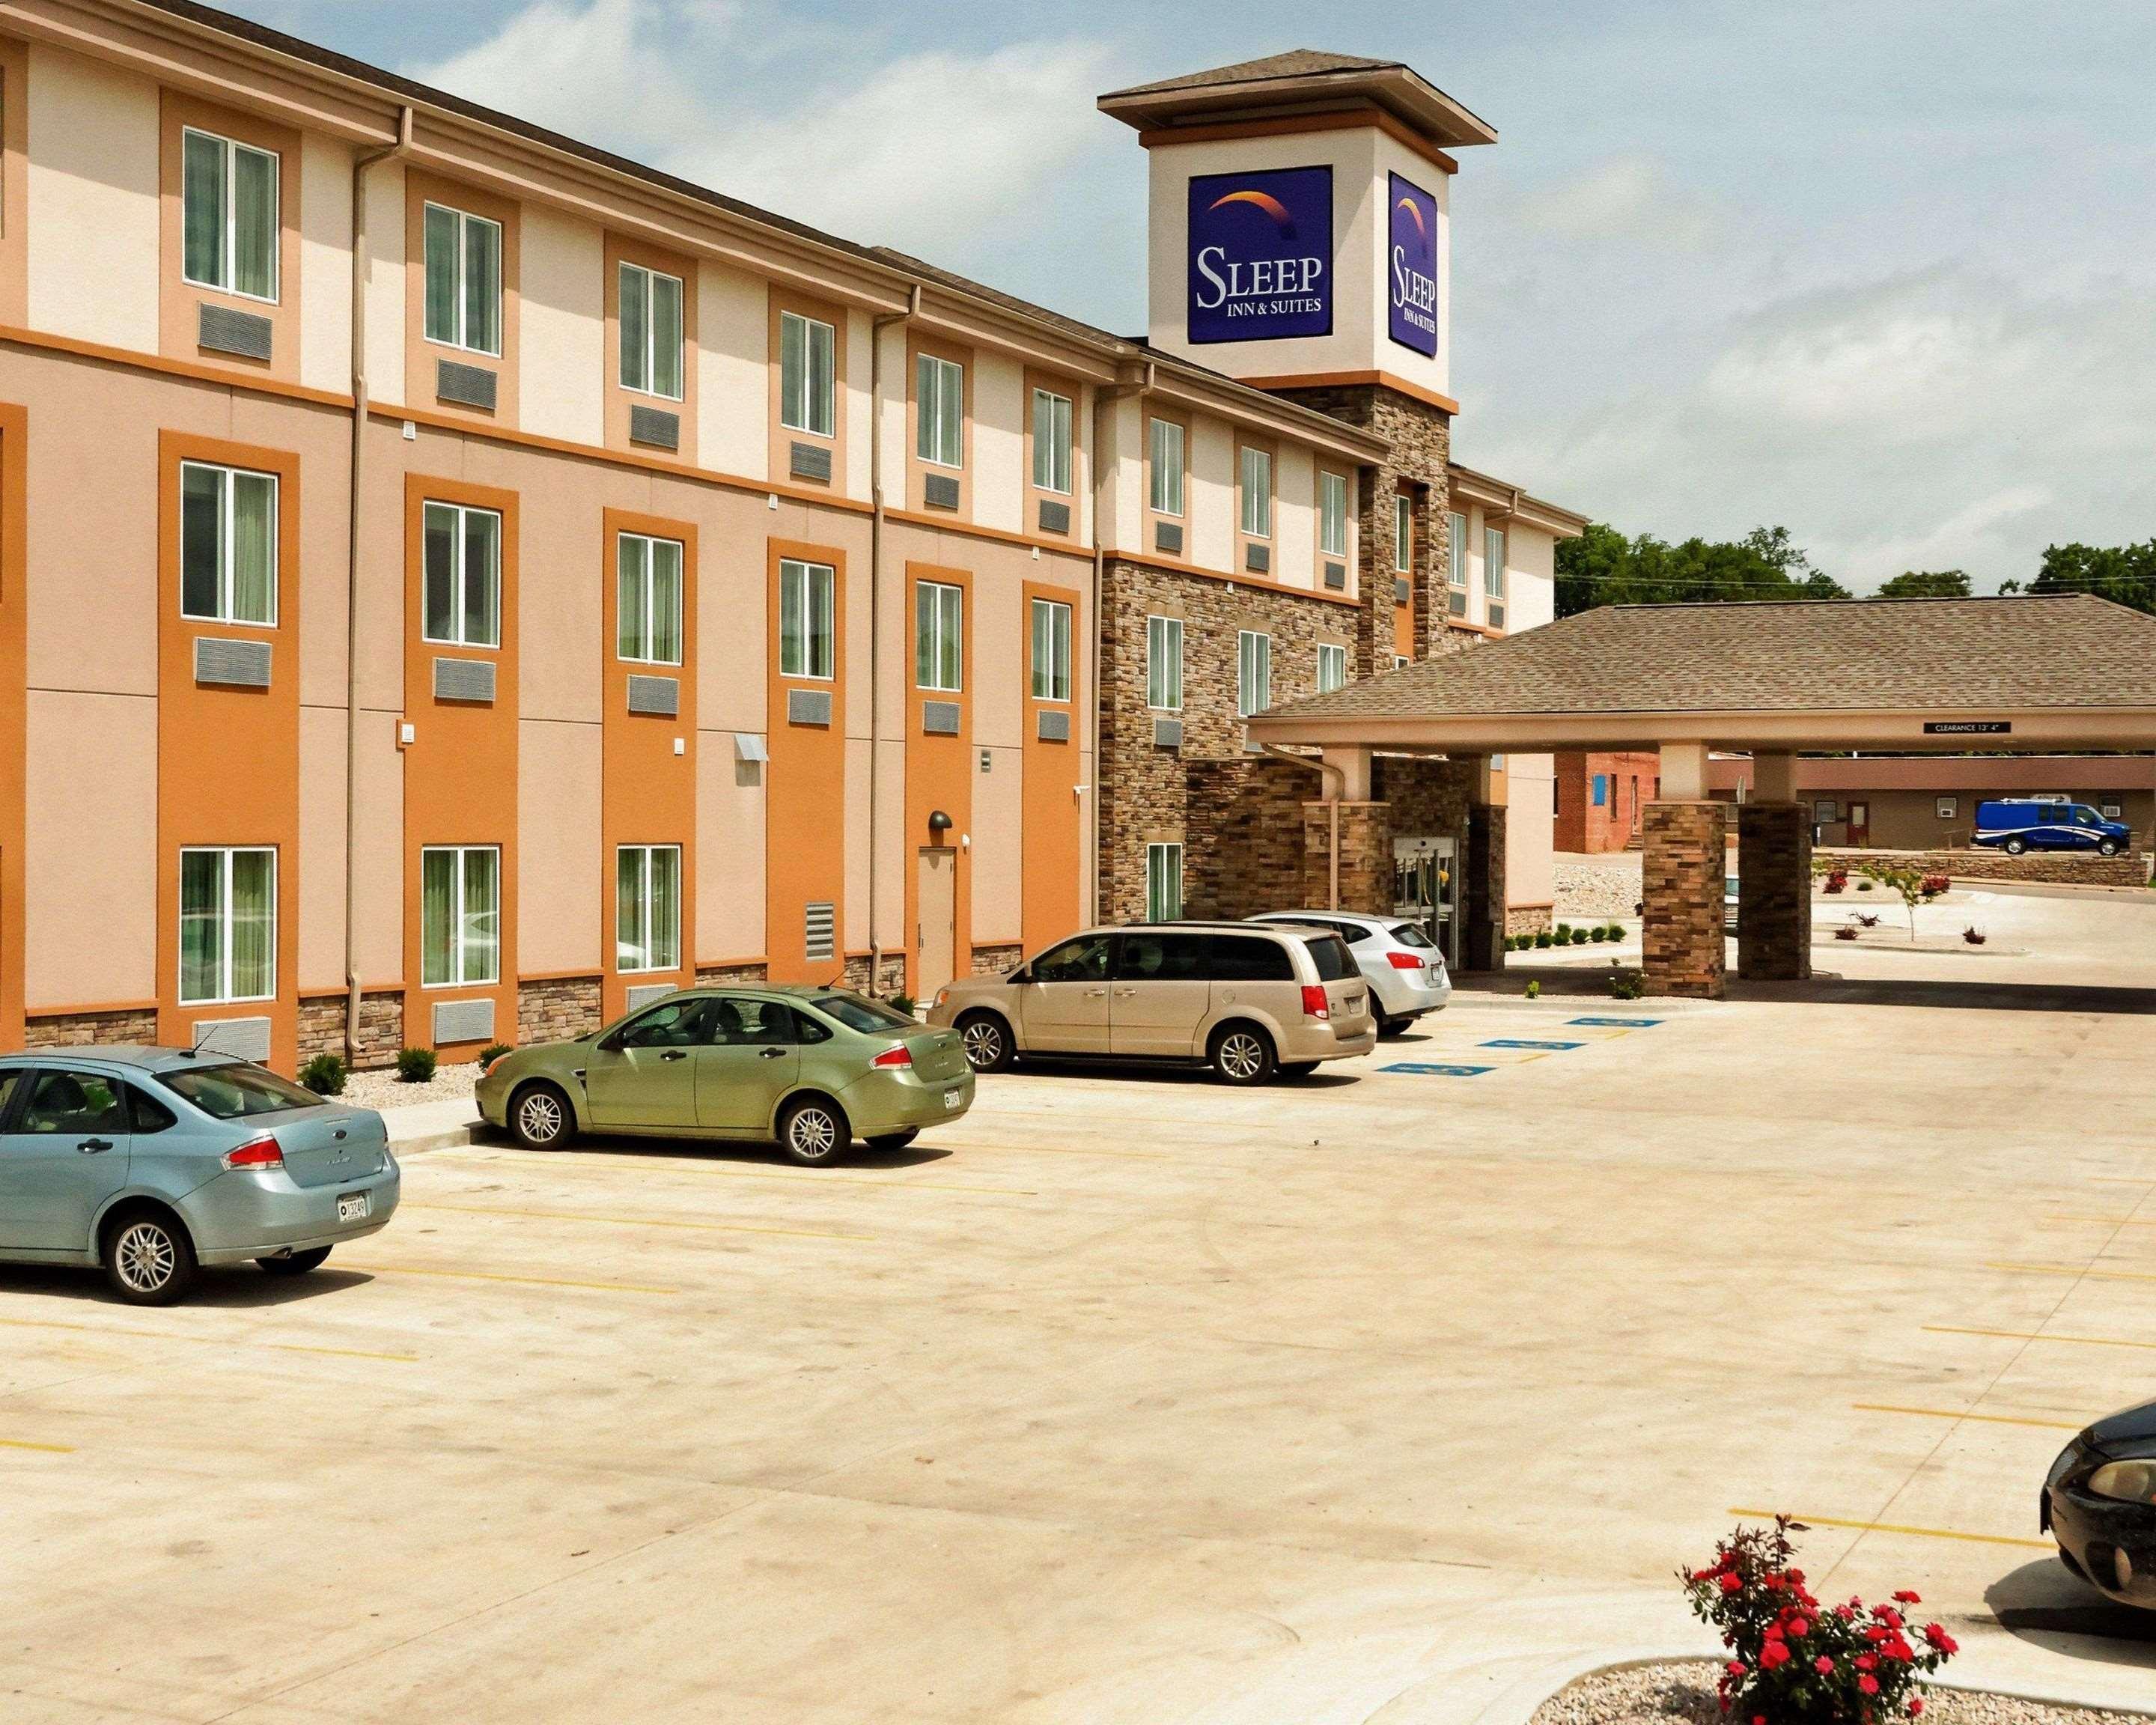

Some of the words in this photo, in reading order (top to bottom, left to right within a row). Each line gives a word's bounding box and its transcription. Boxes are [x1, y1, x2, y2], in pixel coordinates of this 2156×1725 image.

[1196, 246, 1322, 308] SLEEP
[1227, 302, 1255, 317] INN
[1258, 302, 1267, 314] &
[1270, 298, 1321, 314] SUITES
[1393, 245, 1436, 313] SLEEP
